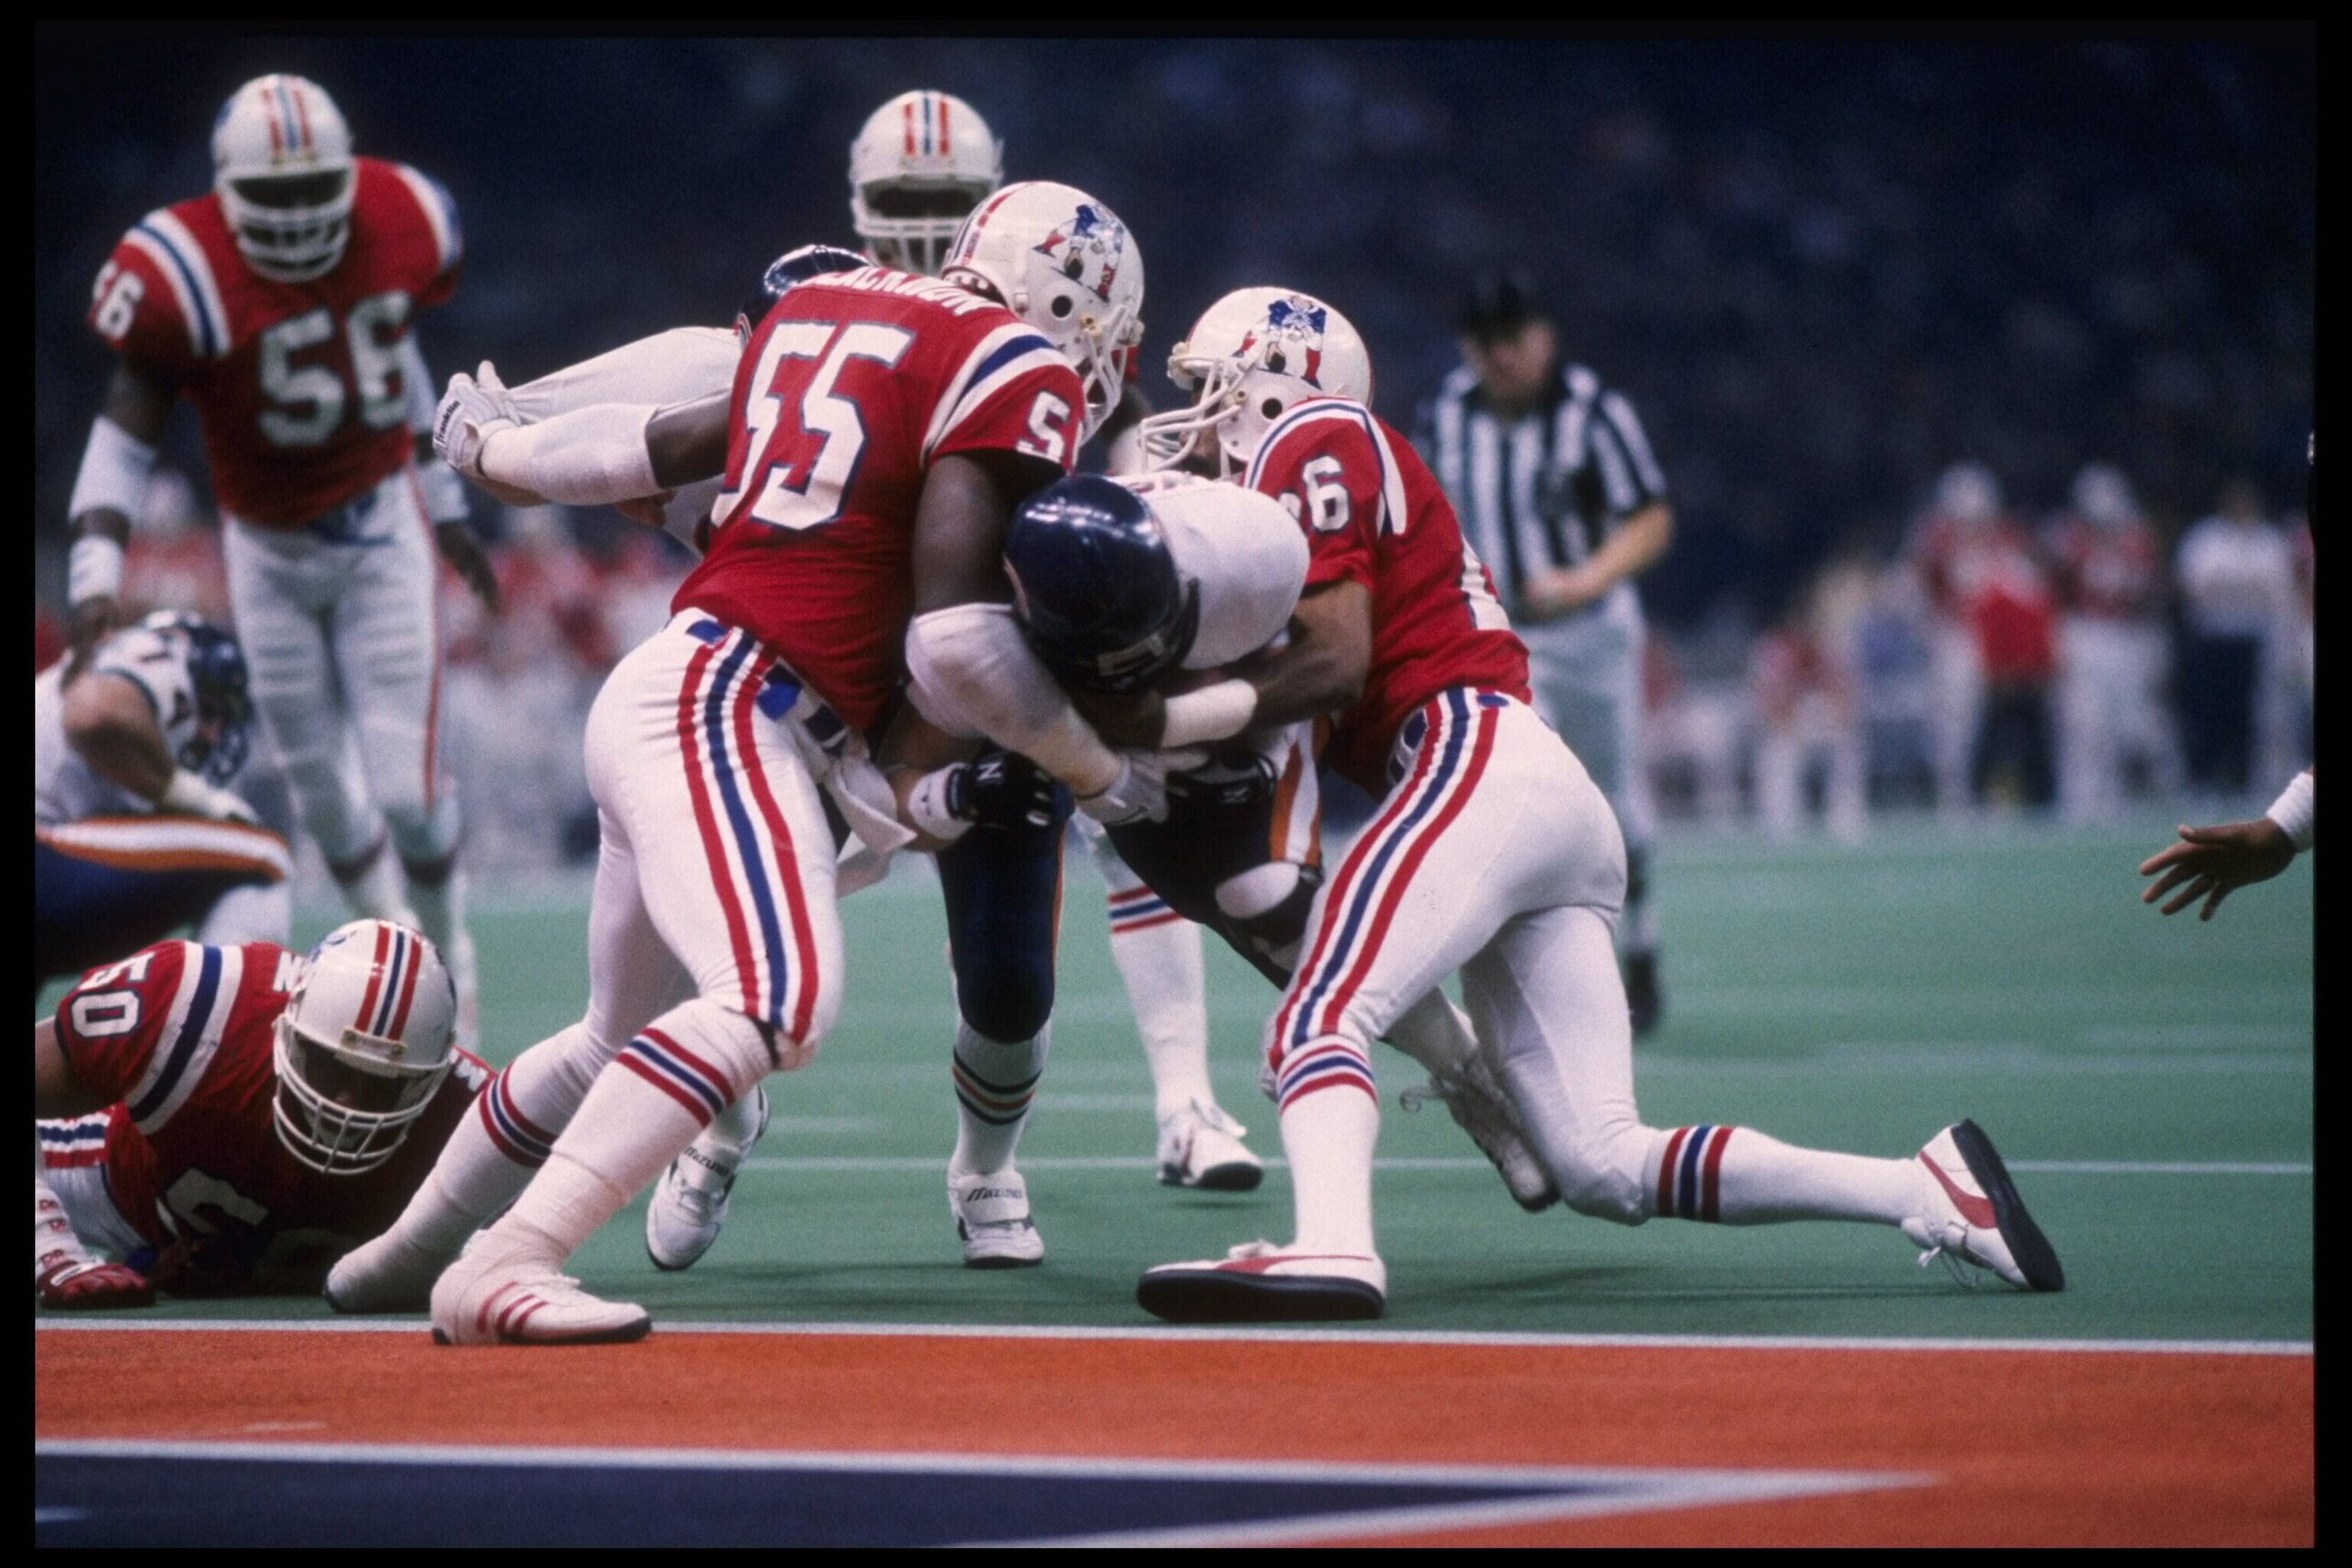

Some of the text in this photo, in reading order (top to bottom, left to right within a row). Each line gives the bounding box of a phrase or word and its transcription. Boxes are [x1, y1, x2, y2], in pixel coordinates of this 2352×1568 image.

[257, 289, 415, 447] 56
[711, 321, 917, 531] 55
[71, 951, 156, 1039] 50
